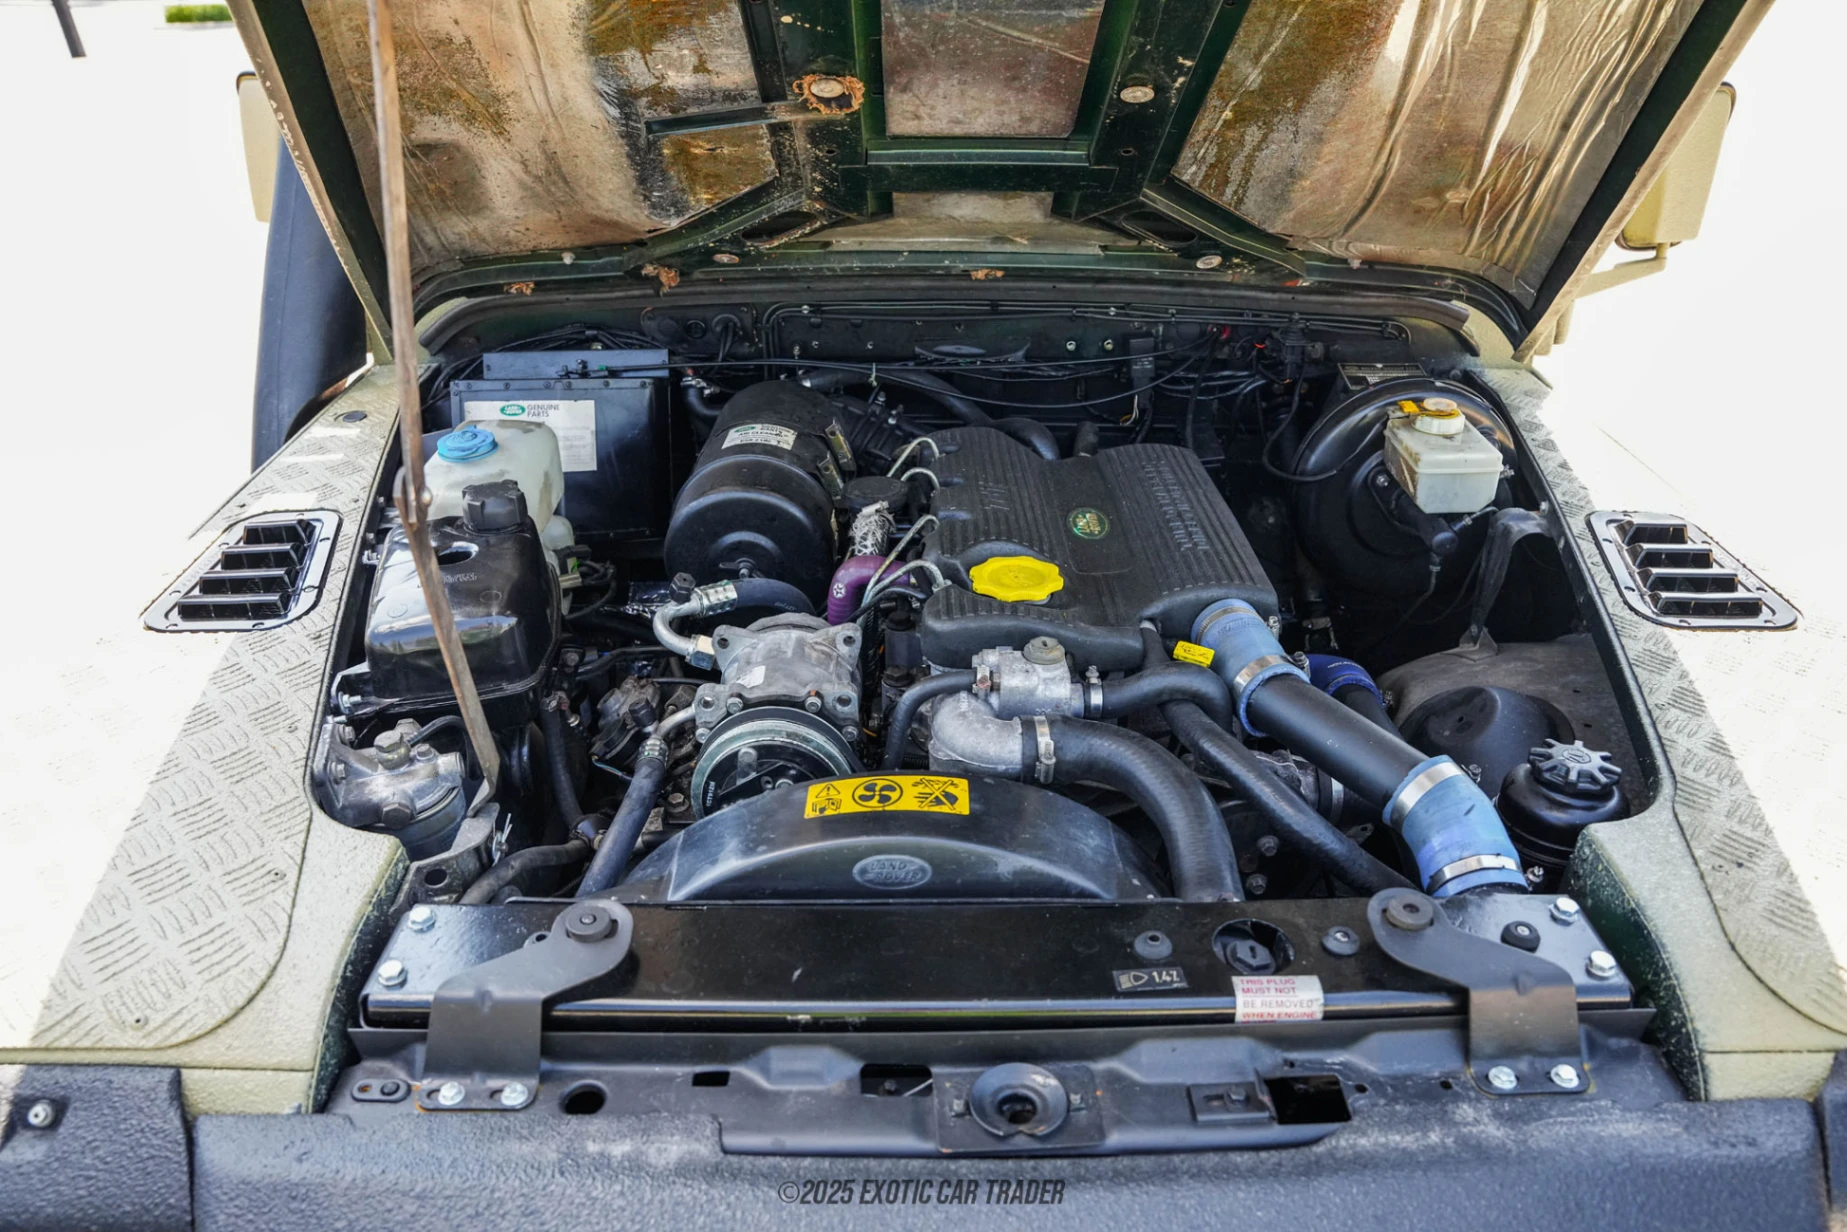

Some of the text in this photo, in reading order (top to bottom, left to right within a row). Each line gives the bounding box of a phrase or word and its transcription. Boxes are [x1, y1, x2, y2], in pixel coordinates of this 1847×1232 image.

[868, 860, 909, 871] LAND
[874, 871, 922, 882] ROVER
[1243, 999, 1314, 1009] BE REMOVED
[1277, 1011, 1317, 1019] ENGINE
